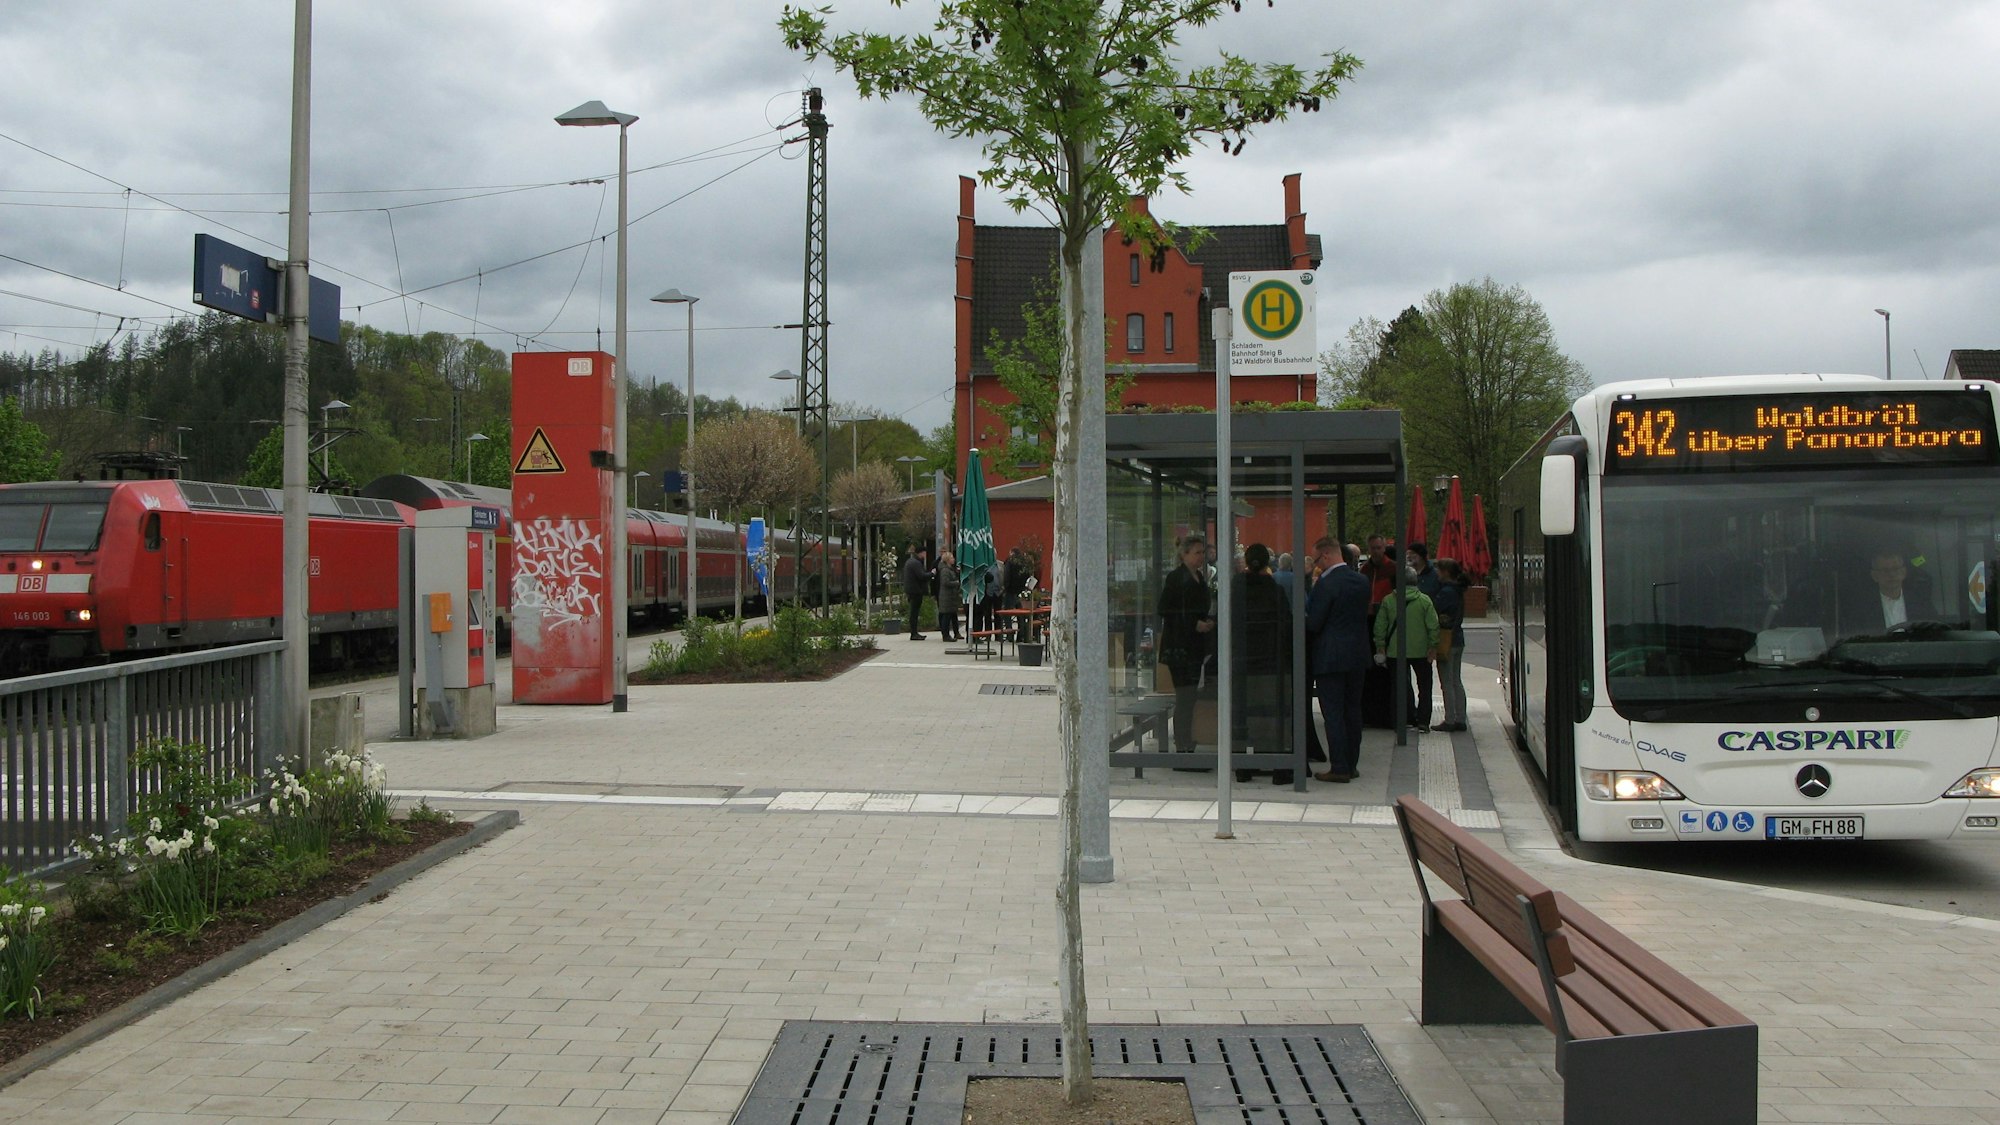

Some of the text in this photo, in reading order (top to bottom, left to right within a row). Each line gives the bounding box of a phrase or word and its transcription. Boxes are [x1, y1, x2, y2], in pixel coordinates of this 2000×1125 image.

[1261, 293, 1285, 326] H
[1244, 357, 1273, 365] Waldbröl
[1274, 356, 1313, 364] Busbahnhof
[1259, 350, 1276, 358] Steig
[571, 361, 589, 373] DB
[1757, 404, 1919, 428] Waldbröl
[1617, 410, 1676, 456] 342
[1688, 427, 1982, 452] über Panarbora
[310, 560, 320, 574] DB
[22, 577, 42, 589] DB
[13, 612, 50, 621] 146 003
[1598, 732, 1620, 744] Auftrag
[1620, 738, 1631, 746] der
[1718, 729, 1899, 751] CASPARI
[1636, 740, 1687, 763] OVAG
[1781, 820, 1856, 834] GM FH 88
